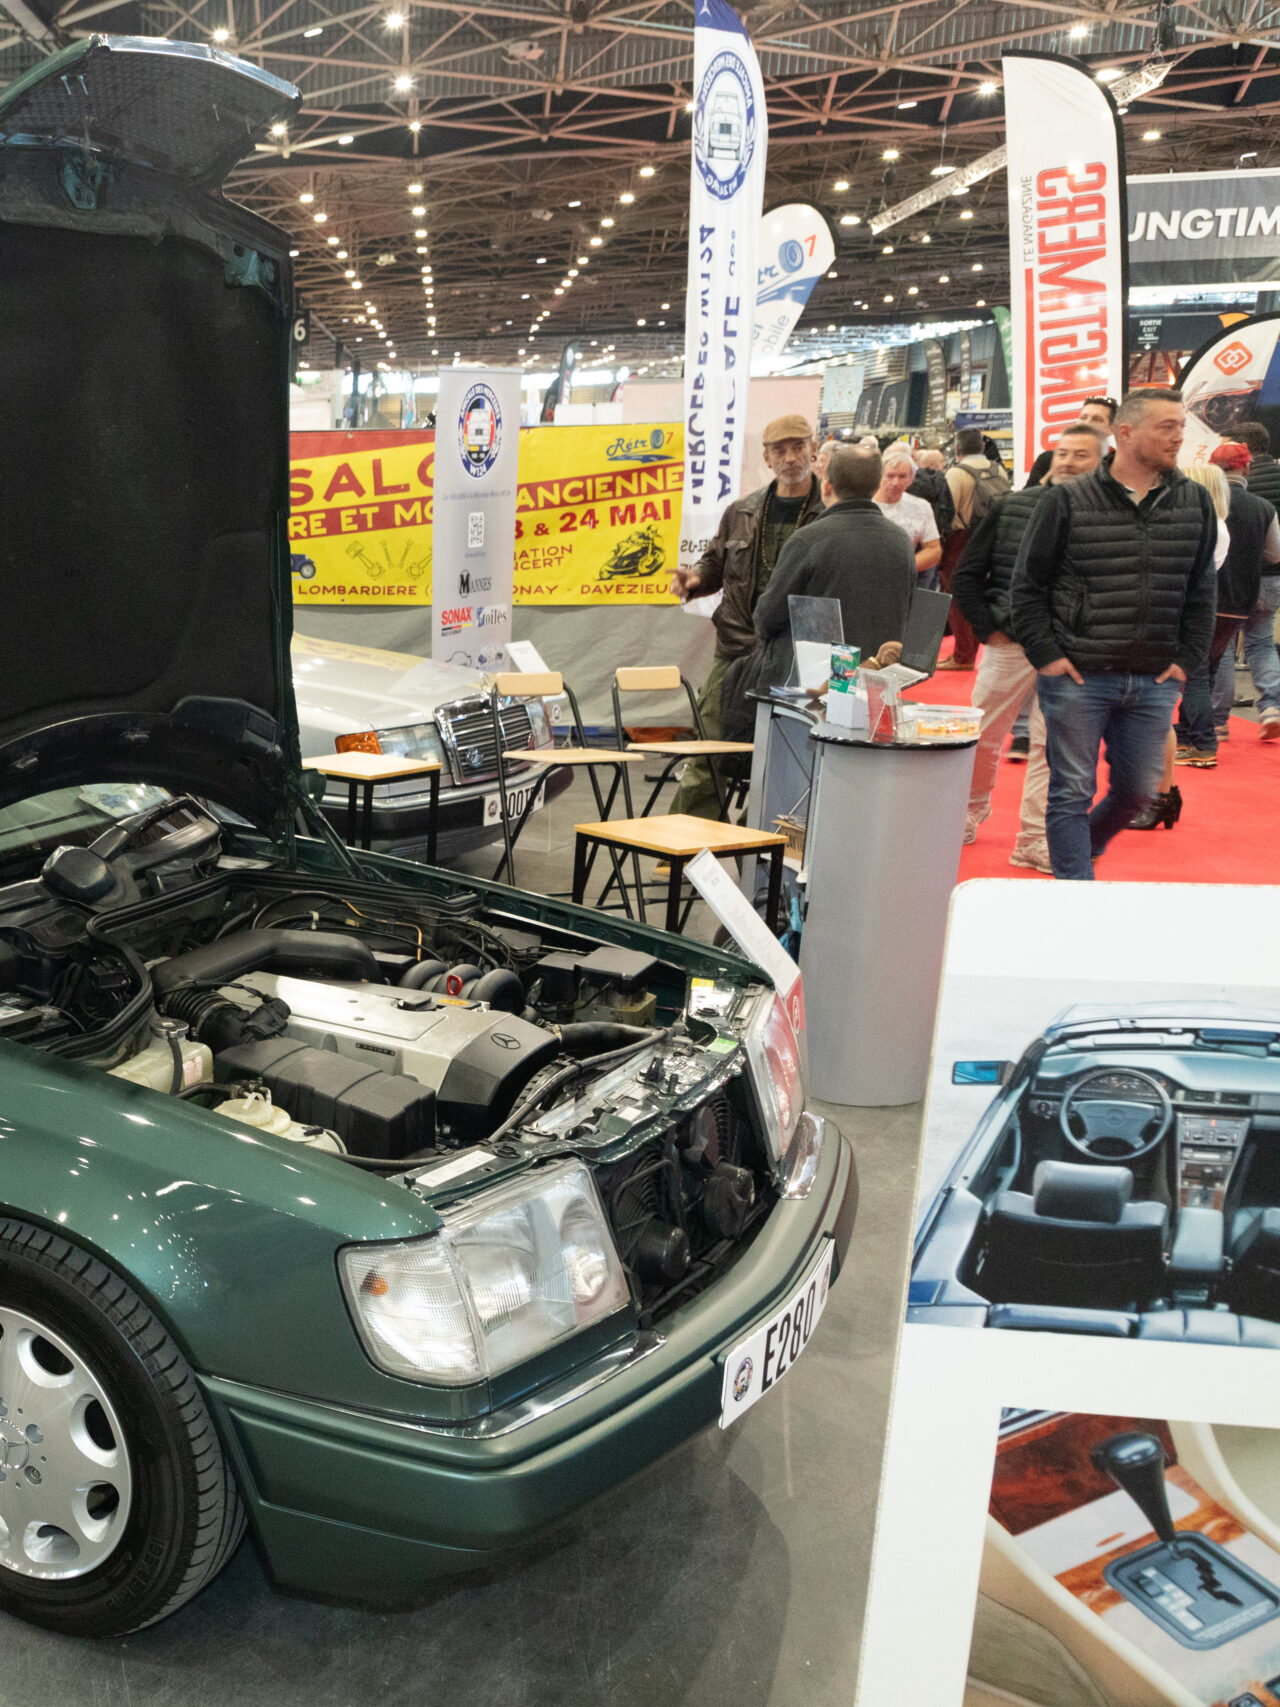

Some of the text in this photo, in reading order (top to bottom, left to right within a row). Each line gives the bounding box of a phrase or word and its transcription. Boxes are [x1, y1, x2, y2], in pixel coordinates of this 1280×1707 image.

[1129, 206, 1280, 241] UNGTIM
[294, 318, 307, 341] 6
[516, 465, 684, 509] ANCIENNE
[288, 512, 327, 538] RE
[339, 506, 380, 532] ET
[534, 523, 550, 536] &
[559, 508, 600, 533] 24
[609, 499, 672, 527] MAI
[513, 543, 573, 560] ATION
[298, 584, 418, 596] LOMBARDIERE
[580, 584, 671, 595] DAVEZIEU
[441, 606, 473, 626] SONAX
[761, 1280, 816, 1394] E280
